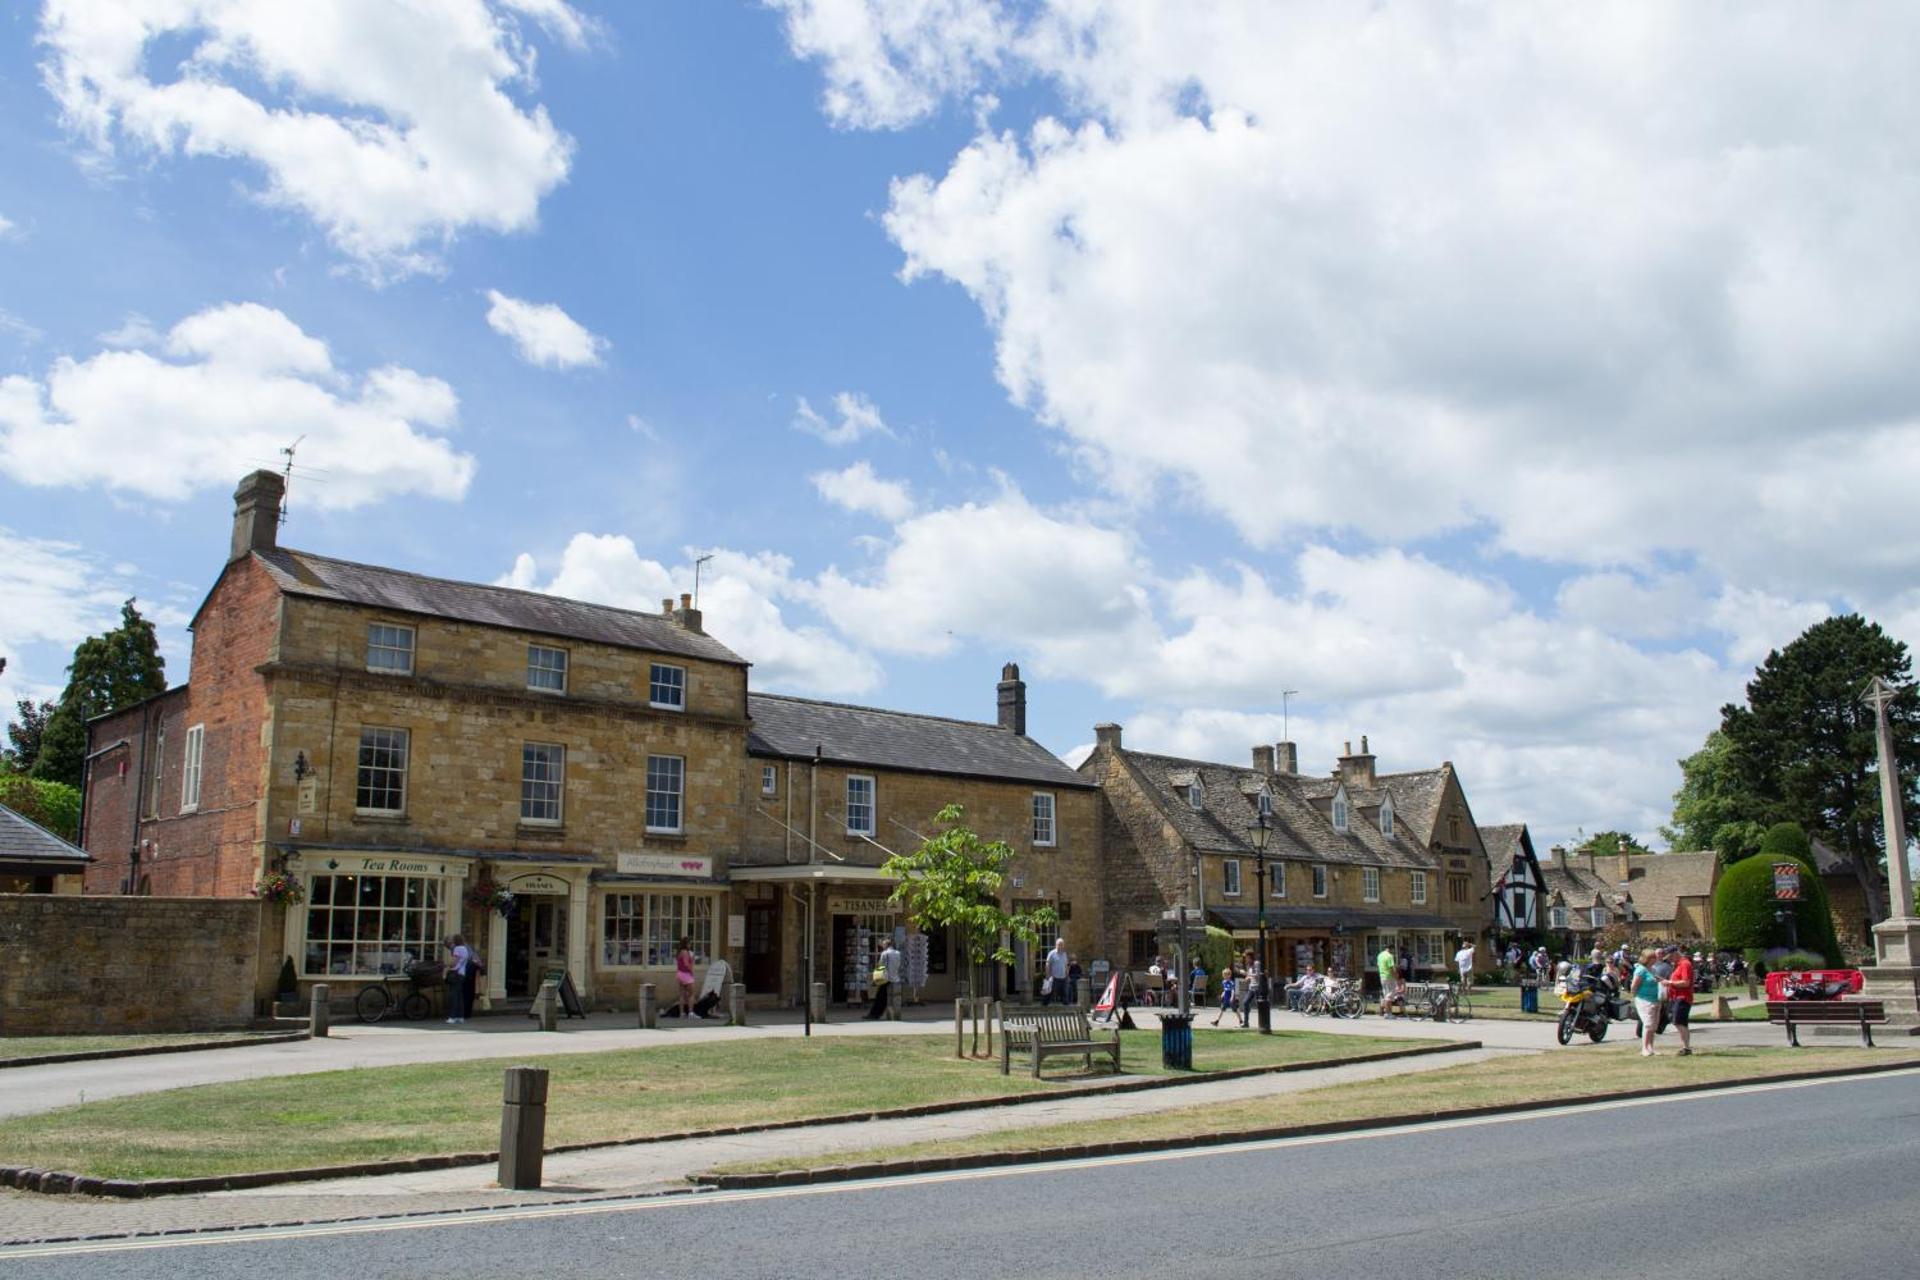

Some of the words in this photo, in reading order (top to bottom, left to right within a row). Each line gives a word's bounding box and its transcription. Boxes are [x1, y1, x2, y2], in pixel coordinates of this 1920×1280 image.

[361, 858, 385, 870] Tea
[389, 859, 429, 872] Rooms
[843, 900, 888, 912] TISANES
